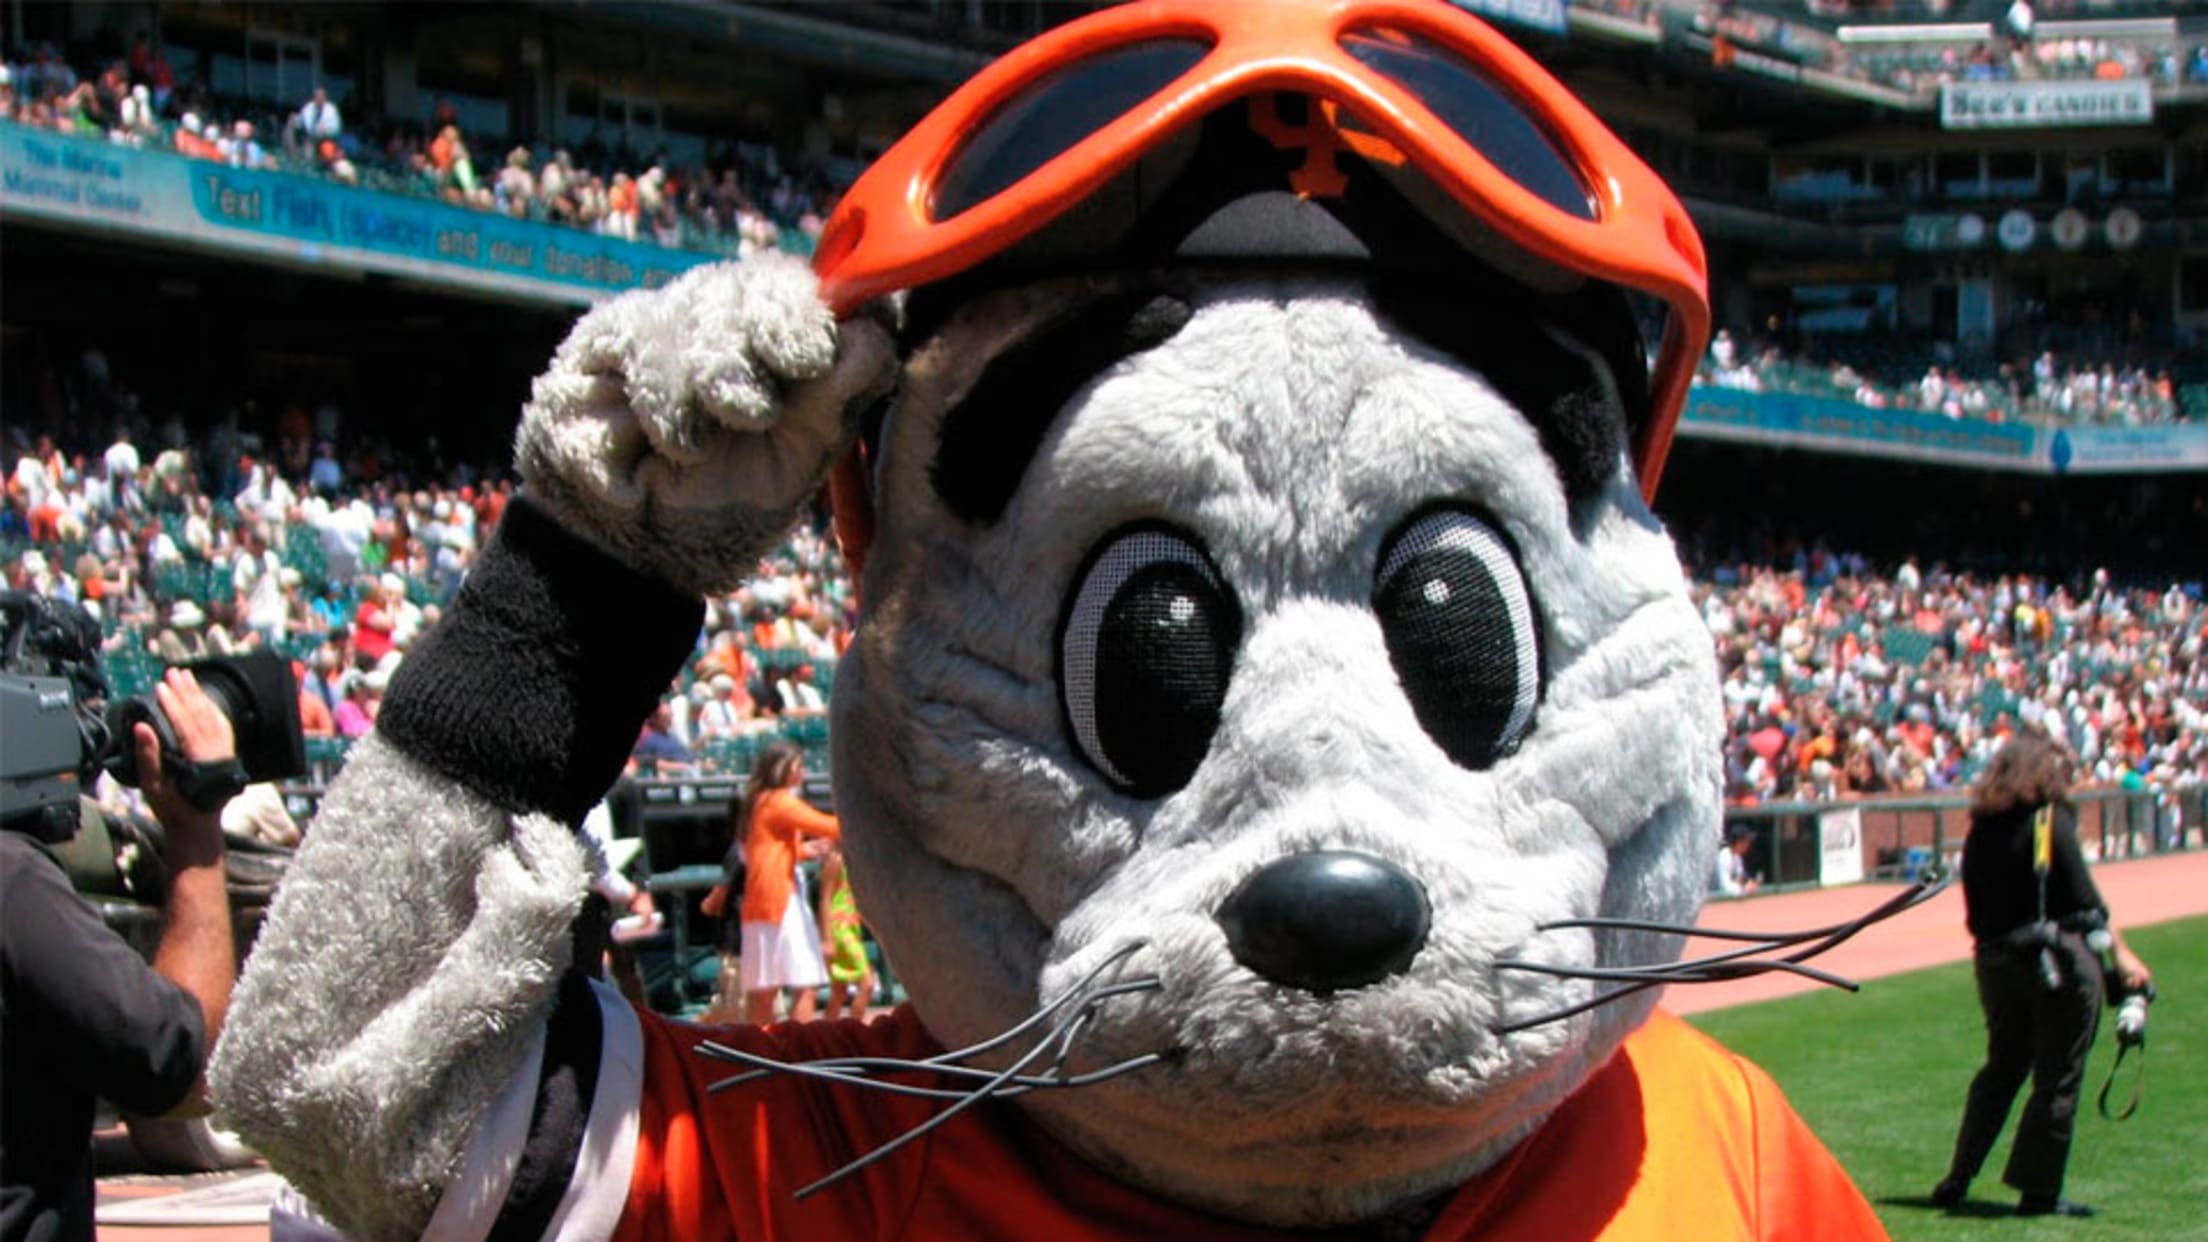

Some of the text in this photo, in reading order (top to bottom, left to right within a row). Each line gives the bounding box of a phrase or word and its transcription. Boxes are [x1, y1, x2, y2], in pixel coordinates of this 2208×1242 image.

[206, 177, 260, 219] Text
[438, 231, 479, 259] and
[547, 246, 633, 282] donation
